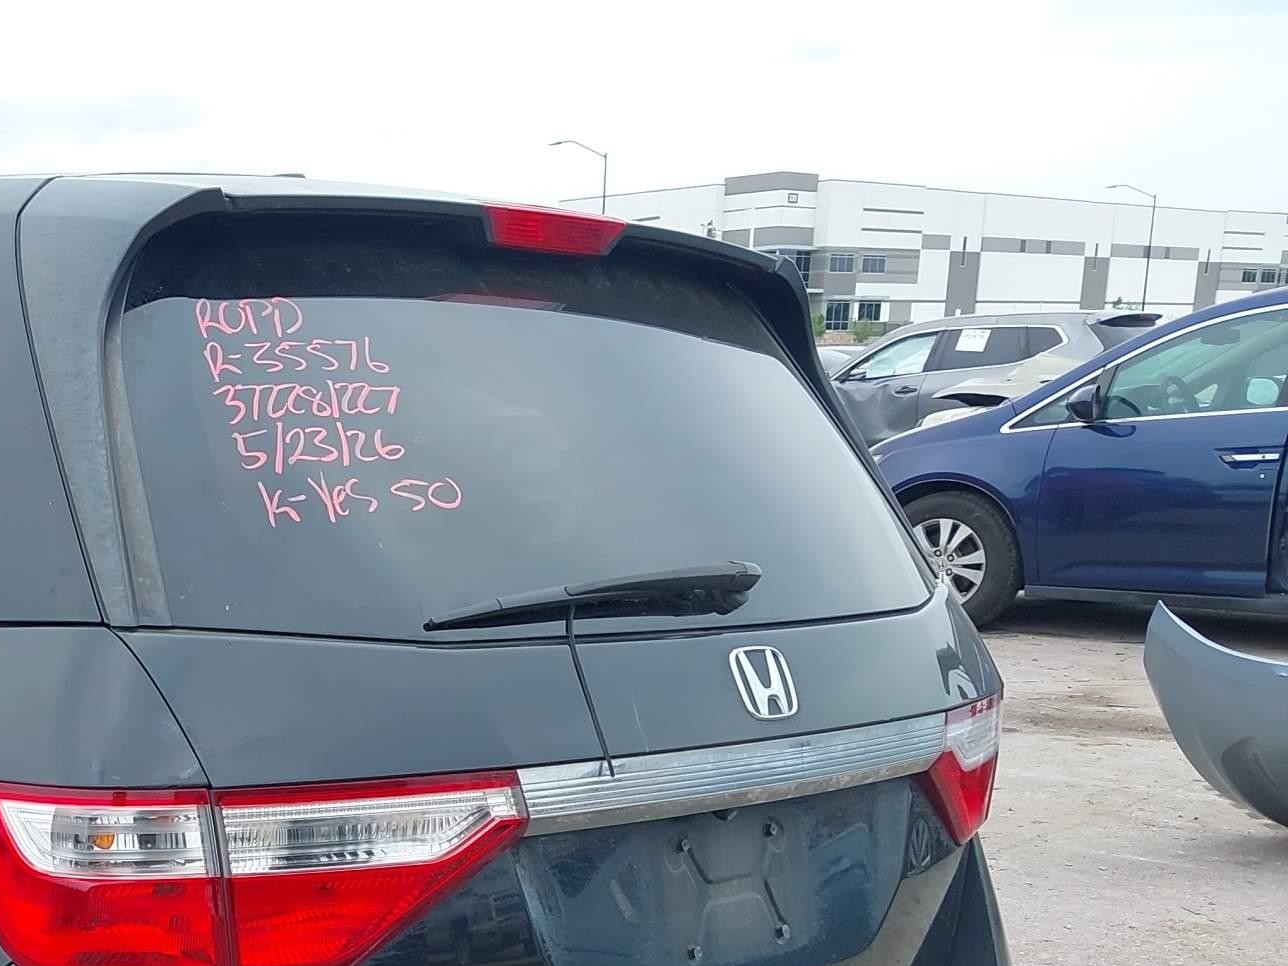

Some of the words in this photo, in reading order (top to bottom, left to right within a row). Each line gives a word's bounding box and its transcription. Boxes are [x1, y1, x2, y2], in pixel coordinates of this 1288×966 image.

[202, 336, 391, 382] R-35576
[231, 421, 406, 475] 5/23/26
[390, 477, 463, 511] 50
